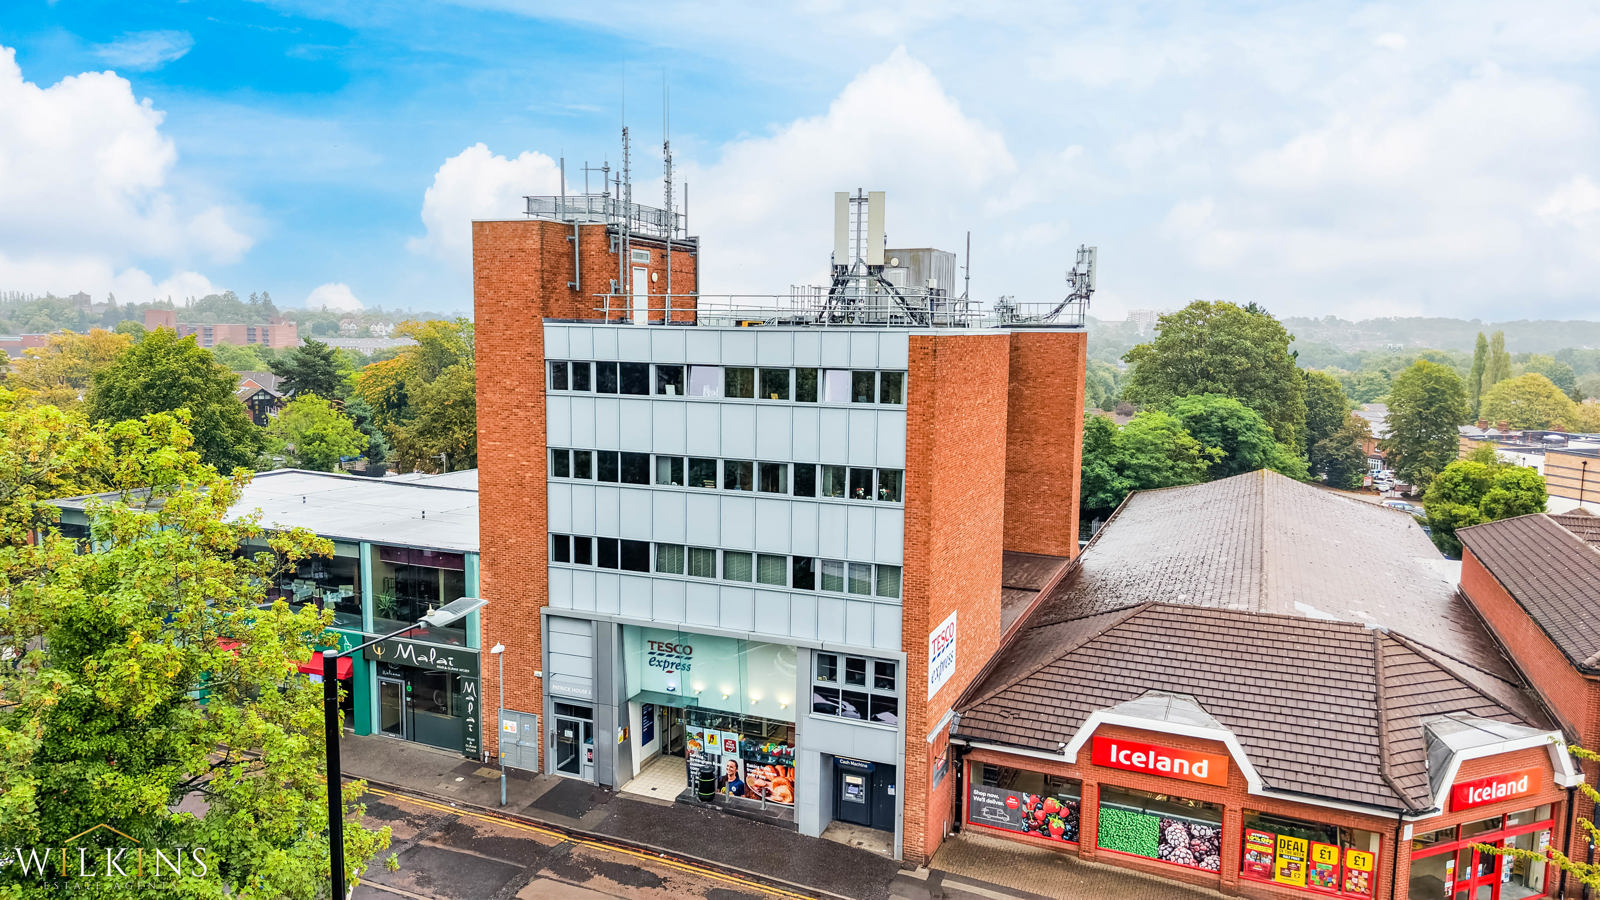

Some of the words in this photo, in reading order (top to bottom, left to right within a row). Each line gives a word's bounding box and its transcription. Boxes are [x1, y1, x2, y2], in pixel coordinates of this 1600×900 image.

[931, 621, 955, 655] TESCO
[647, 640, 693, 655] TESCO
[648, 656, 692, 671] express
[931, 650, 954, 684] express
[571, 687, 588, 695] HOUSE
[850, 761, 868, 769] Machine
[1110, 744, 1208, 778] Iceland
[973, 789, 987, 797] Shop
[1468, 775, 1528, 804] Iceland
[986, 798, 1005, 806] deliver.
[1279, 838, 1305, 853] DEAL
[1320, 849, 1331, 860] £1
[1353, 855, 1366, 867] £1
